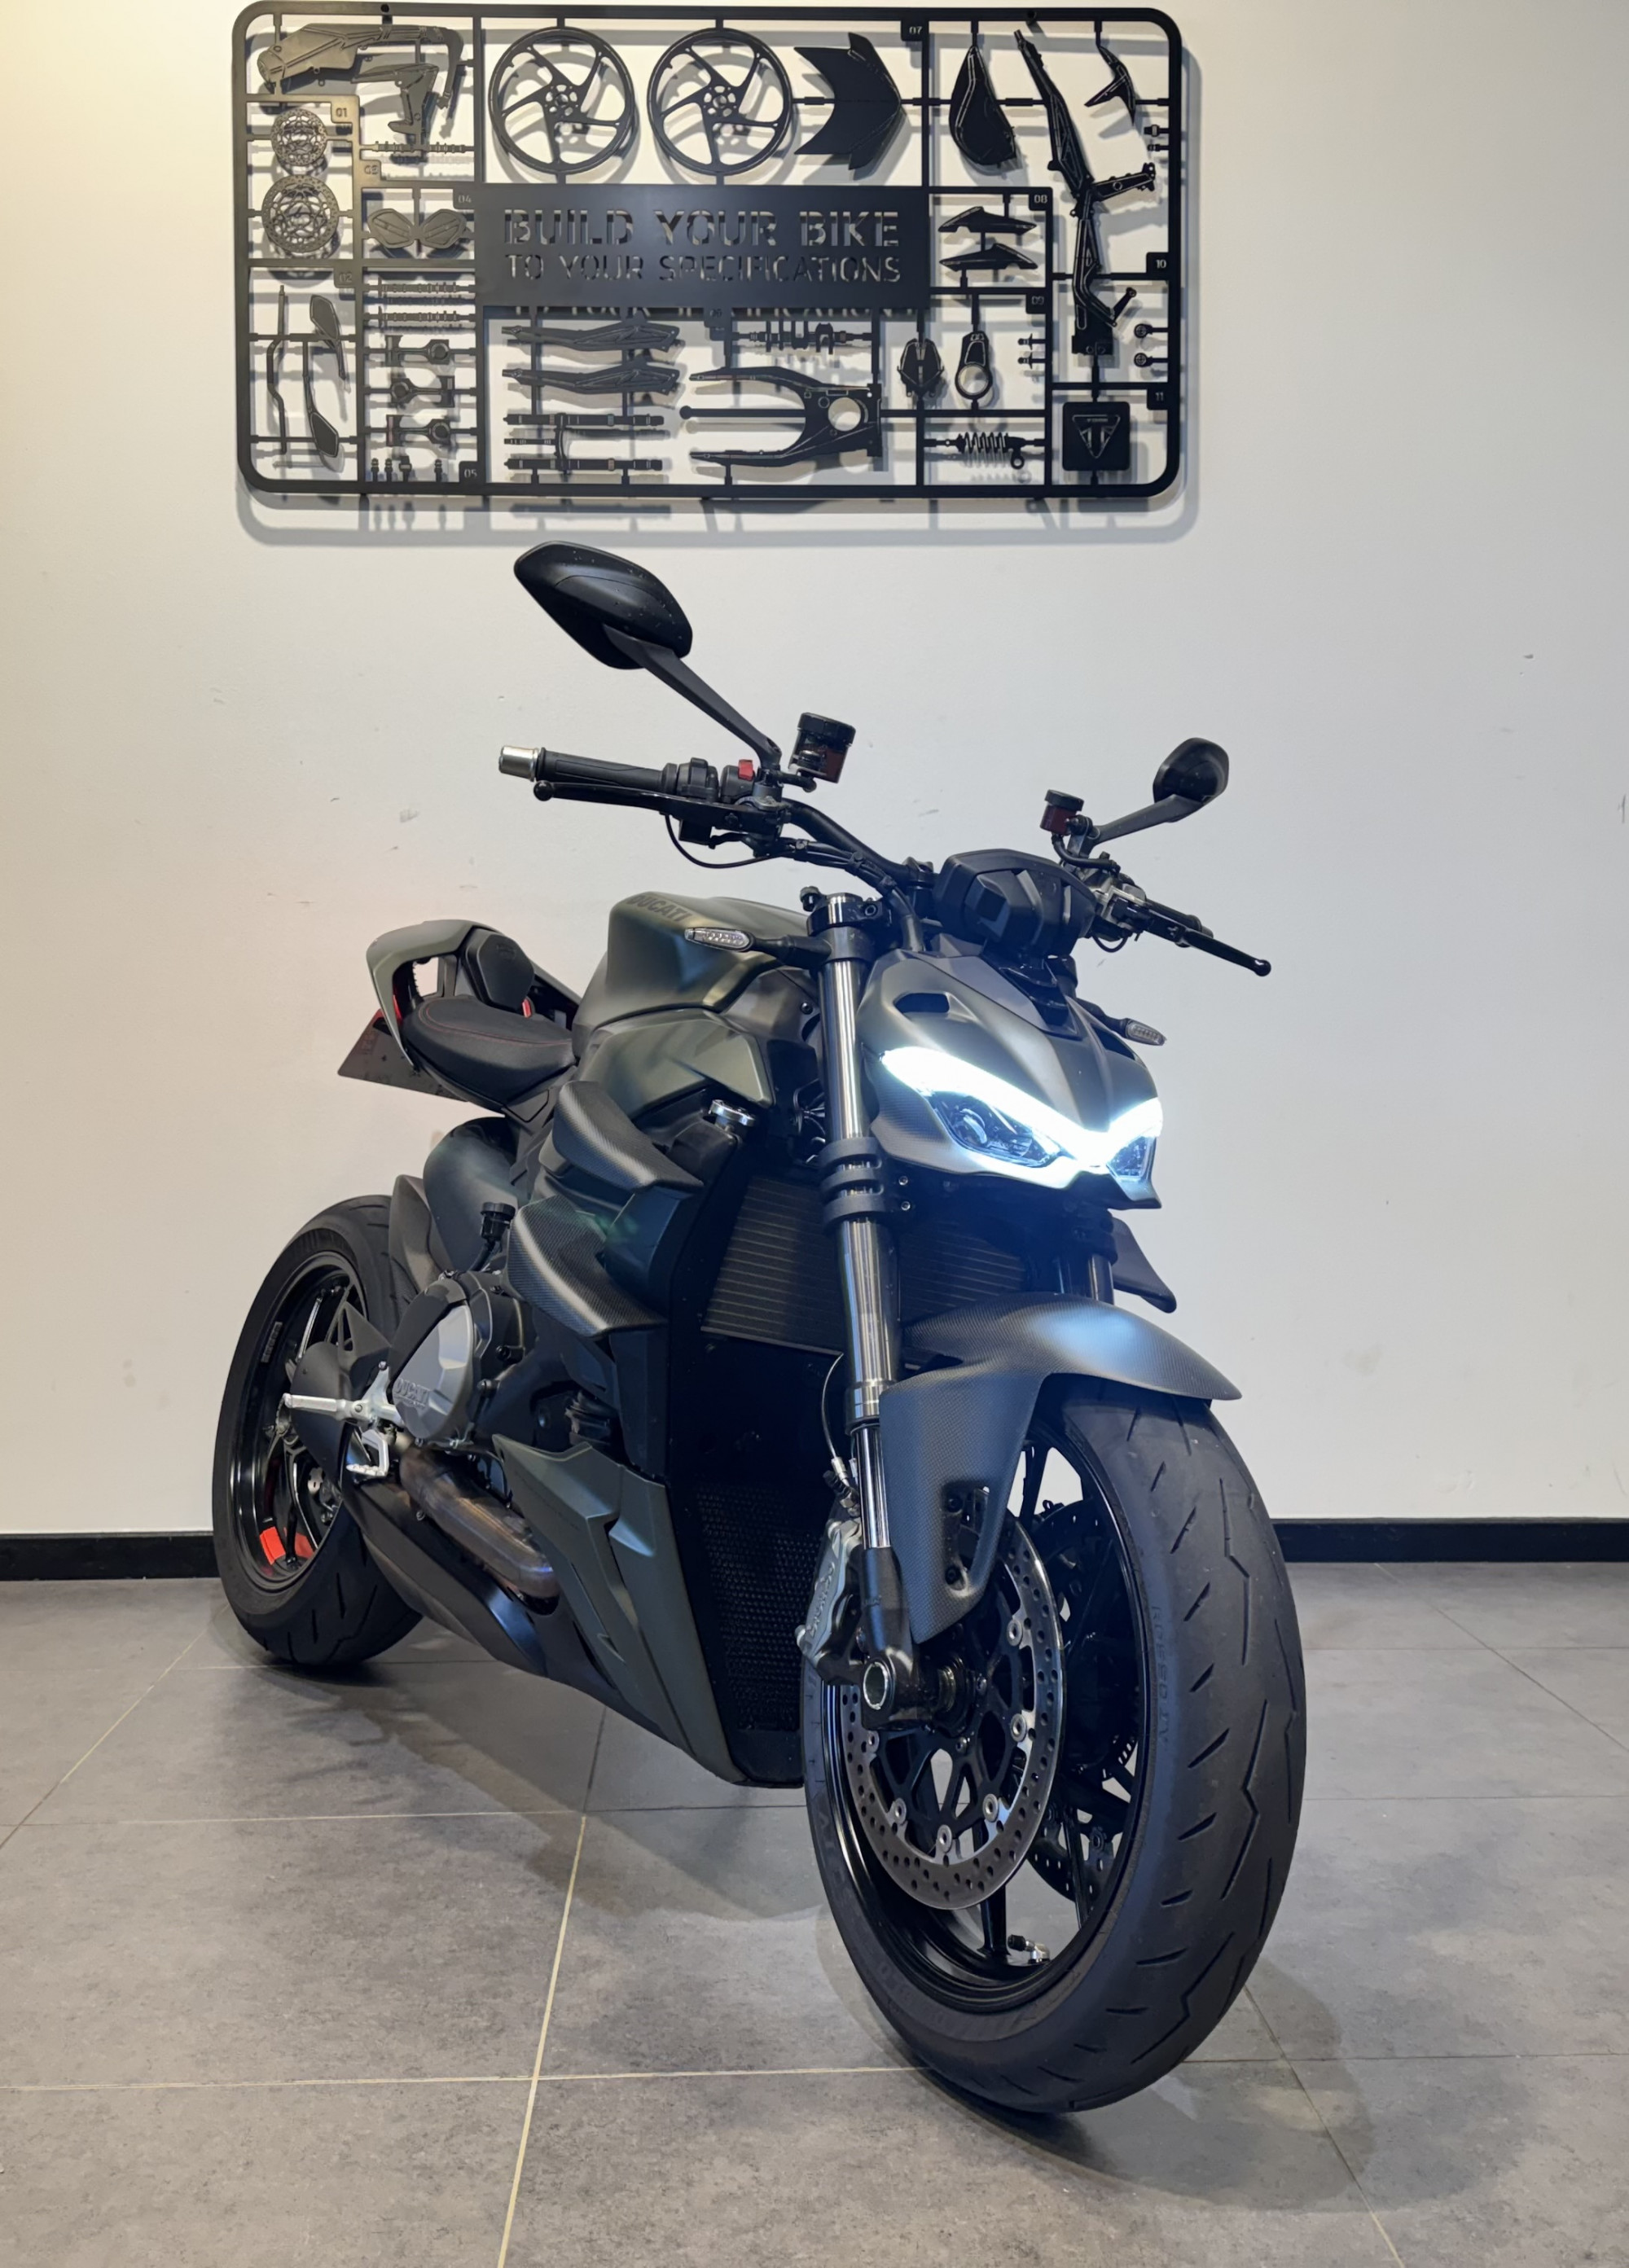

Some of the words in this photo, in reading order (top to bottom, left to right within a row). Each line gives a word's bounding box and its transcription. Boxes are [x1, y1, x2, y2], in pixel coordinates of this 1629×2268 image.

[909, 26, 923, 35] 07
[336, 107, 348, 117] 01
[458, 195, 472, 204] 04
[1034, 194, 1048, 204] 08
[503, 208, 634, 245] BUILD
[654, 209, 777, 247] YOUR
[799, 211, 900, 247] BIKE
[505, 254, 544, 281] TO
[560, 254, 644, 282] YOUR
[659, 255, 902, 283] SPECIFICATIONS
[1156, 259, 1167, 269] 10
[339, 271, 352, 283] 02
[1031, 296, 1044, 305] 09
[1155, 392, 1164, 401] 11
[463, 469, 477, 478] 05
[626, 895, 692, 922] DUCATI
